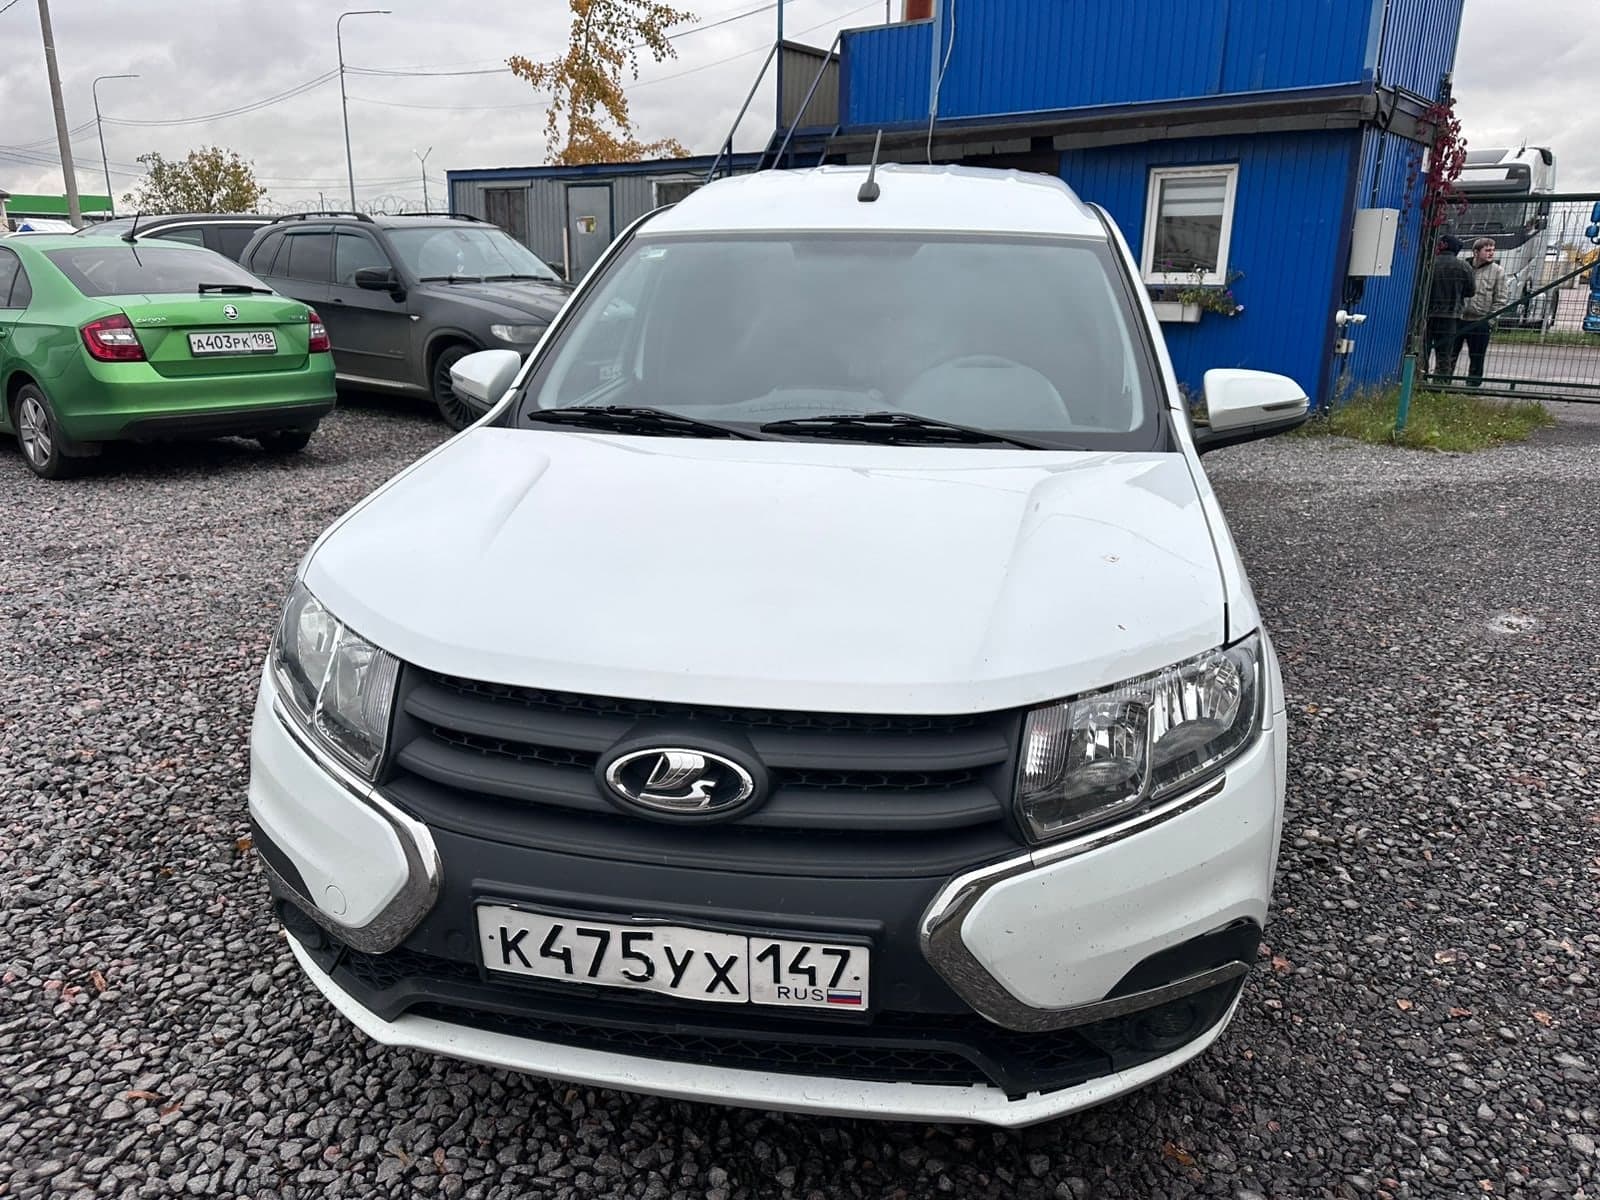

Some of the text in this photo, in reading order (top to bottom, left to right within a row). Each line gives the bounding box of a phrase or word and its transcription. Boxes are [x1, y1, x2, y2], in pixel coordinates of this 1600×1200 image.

[197, 333, 271, 350] А403РК 198
[500, 924, 851, 995] К475УХ 147
[777, 986, 824, 1001] RUS
